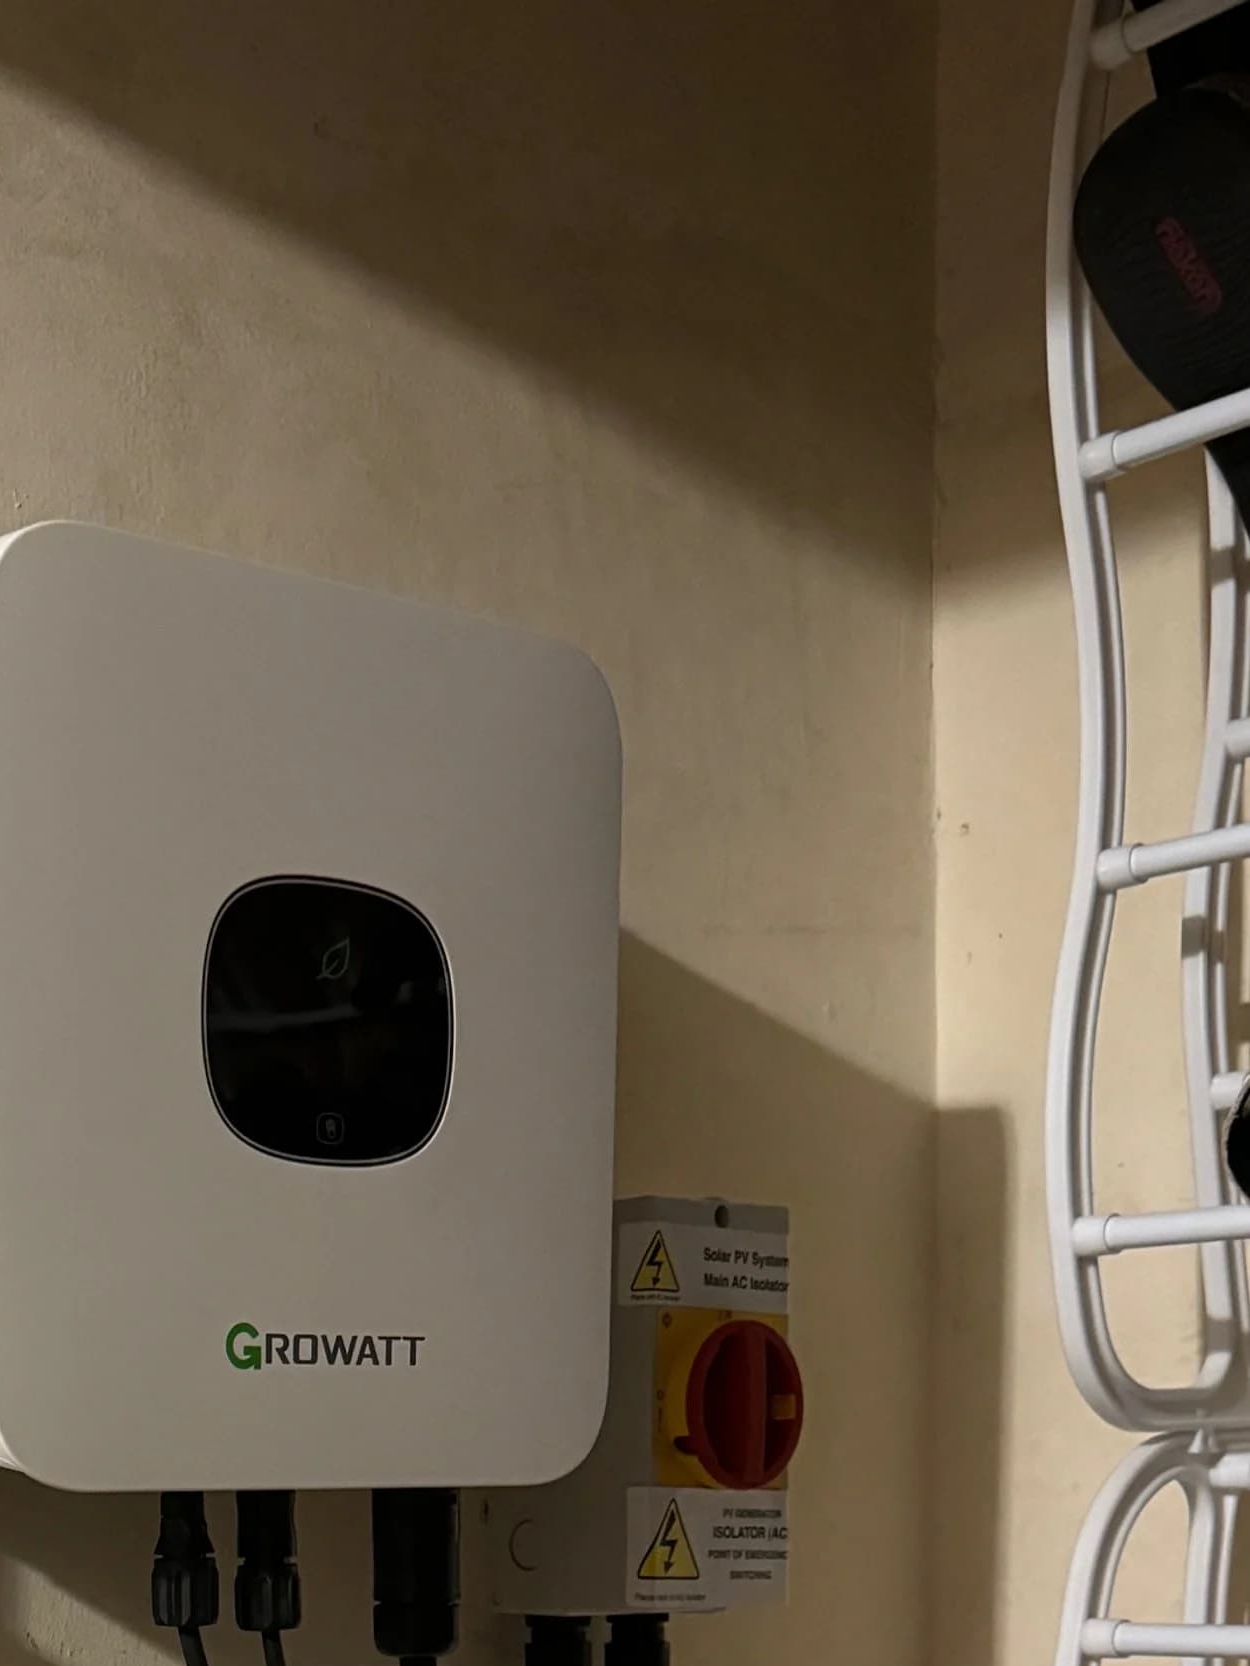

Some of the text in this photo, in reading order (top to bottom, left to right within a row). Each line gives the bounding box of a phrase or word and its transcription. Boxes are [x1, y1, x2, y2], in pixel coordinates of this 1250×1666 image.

[703, 1246, 731, 1264] Solar
[734, 1249, 749, 1265] PV
[703, 1272, 789, 1292] Main AC Isolator
[225, 1322, 426, 1371] GROWATT
[712, 1525, 765, 1540] ISOLATOR
